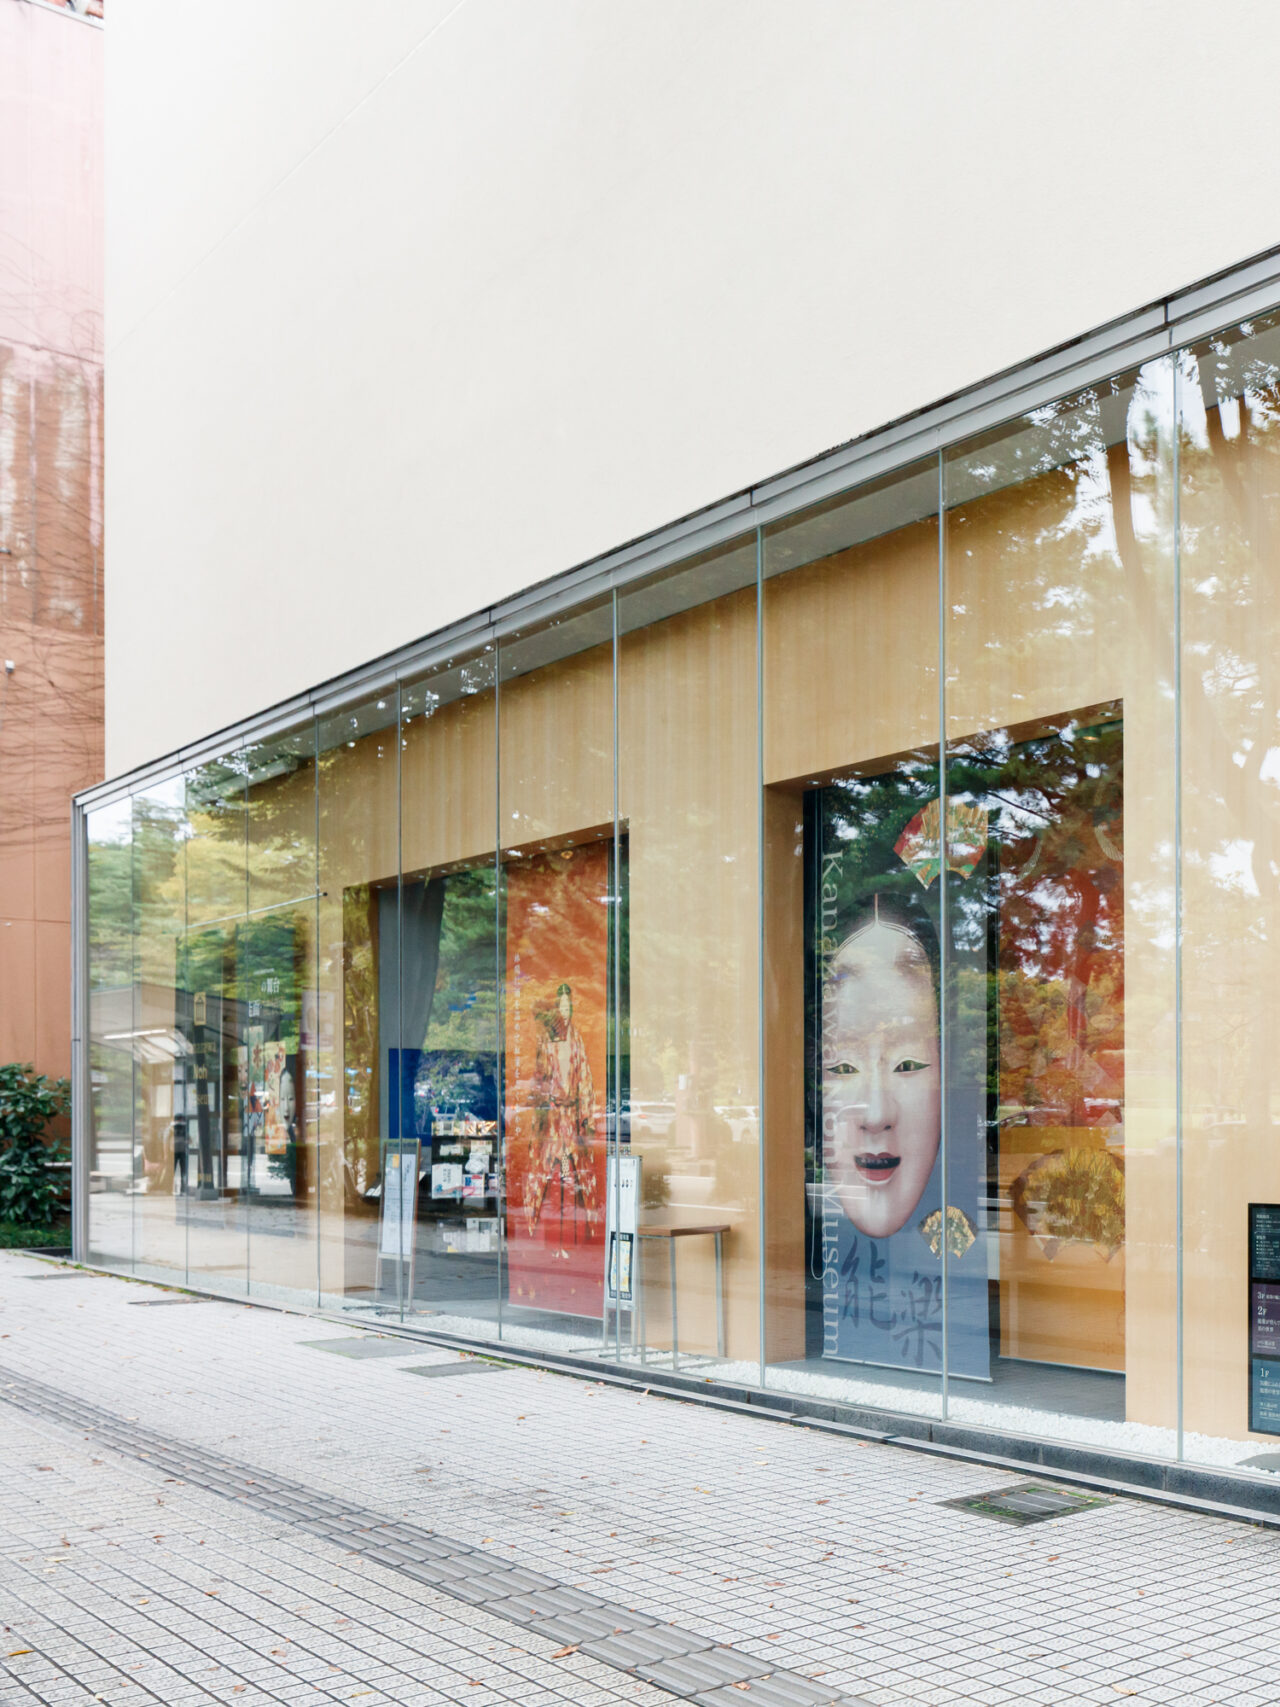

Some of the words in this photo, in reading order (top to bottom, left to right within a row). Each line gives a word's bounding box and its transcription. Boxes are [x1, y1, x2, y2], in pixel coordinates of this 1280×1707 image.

[822, 849, 844, 1067] Kanazawa
[822, 1181, 844, 1356] Museum
[1257, 1306, 1267, 1317] 2F
[1260, 1367, 1270, 1378] 1F
